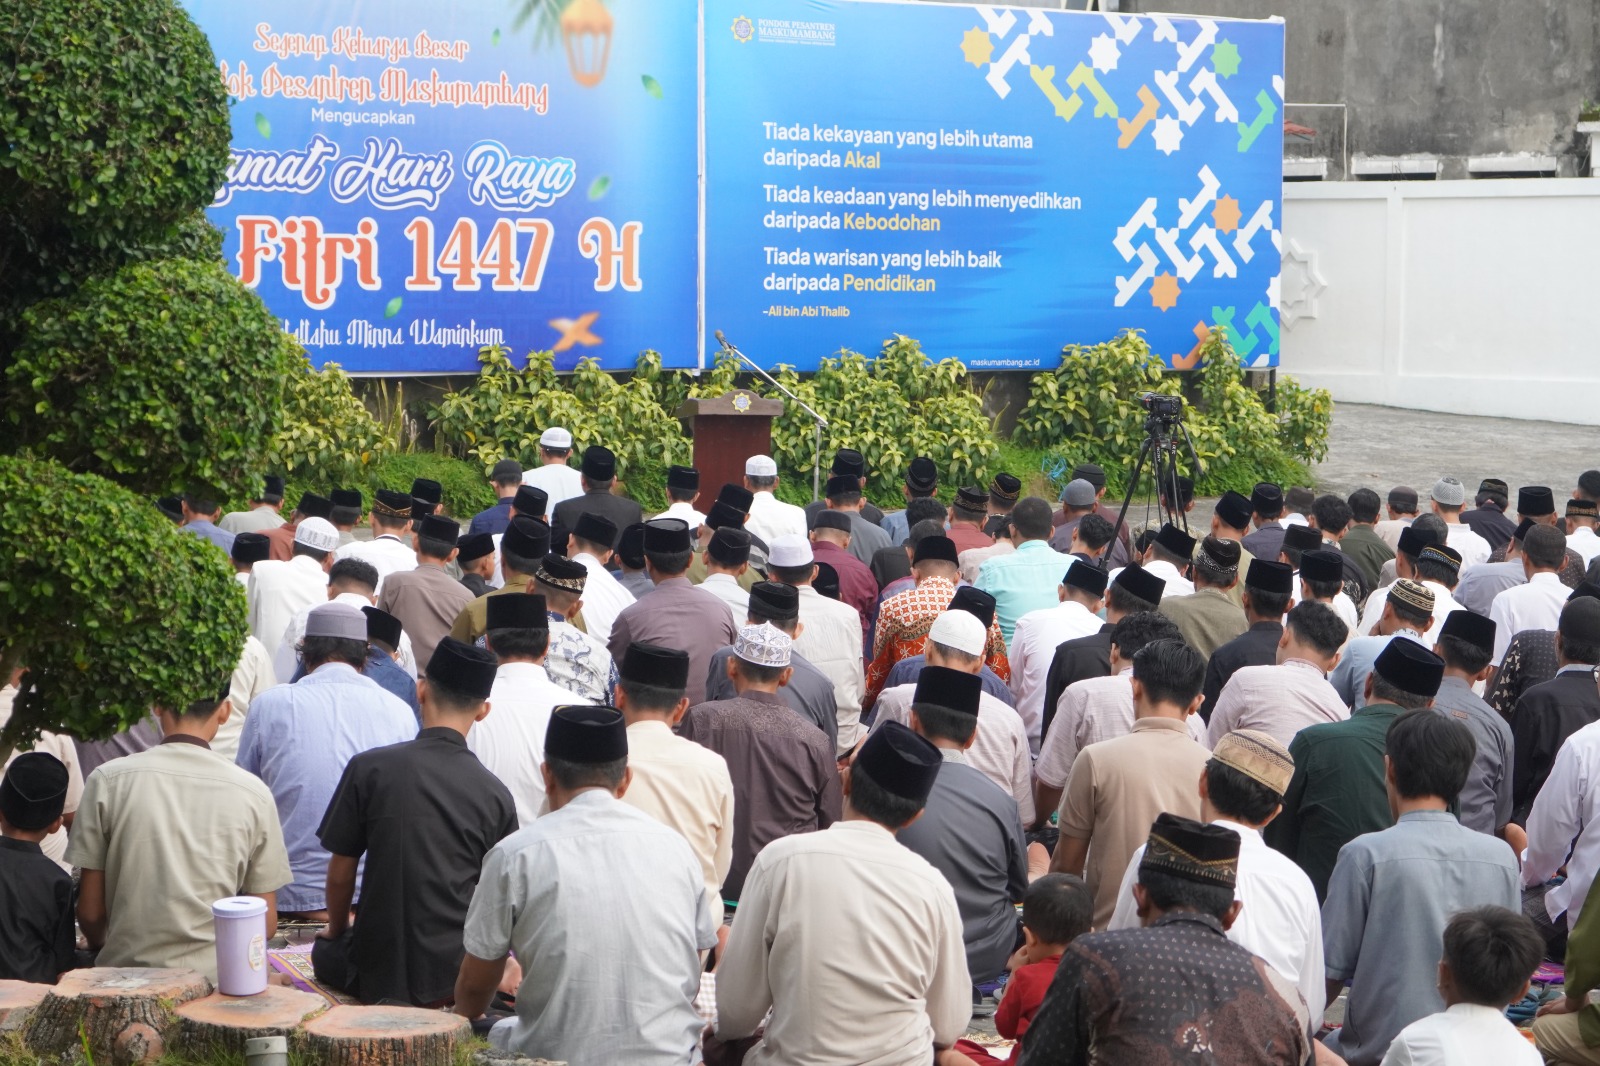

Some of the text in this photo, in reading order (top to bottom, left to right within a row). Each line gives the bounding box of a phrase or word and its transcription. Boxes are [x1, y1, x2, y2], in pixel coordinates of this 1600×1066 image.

[758, 19, 835, 31] PONDOK PESANTREN
[758, 27, 835, 40] MASKUMAMBANG
[253, 22, 469, 63] Segenap Keluarga Besar
[261, 61, 376, 105] Pesantren
[311, 107, 416, 126] Mengucapkan
[763, 121, 1033, 150] Tiada kekayaan yang lebih utama
[763, 147, 881, 171] daripada Akal
[329, 136, 454, 210] Hari
[462, 138, 576, 212] Raya
[763, 184, 1082, 212] Tiada keadaan yang lebih menyedihkan
[763, 210, 941, 232] daripada Kebodohan
[236, 215, 643, 310] Fitri 1447 H
[763, 247, 1002, 271] Tiada warisan yang lebih baik
[763, 272, 936, 294] daripada Pendidikan
[783, 305, 799, 317] bin
[801, 305, 818, 317] Abi
[820, 305, 850, 317] Thalib
[347, 318, 405, 349] Minna
[409, 318, 505, 349] Waminkum
[970, 358, 1040, 368] maskumambang.ac.id
